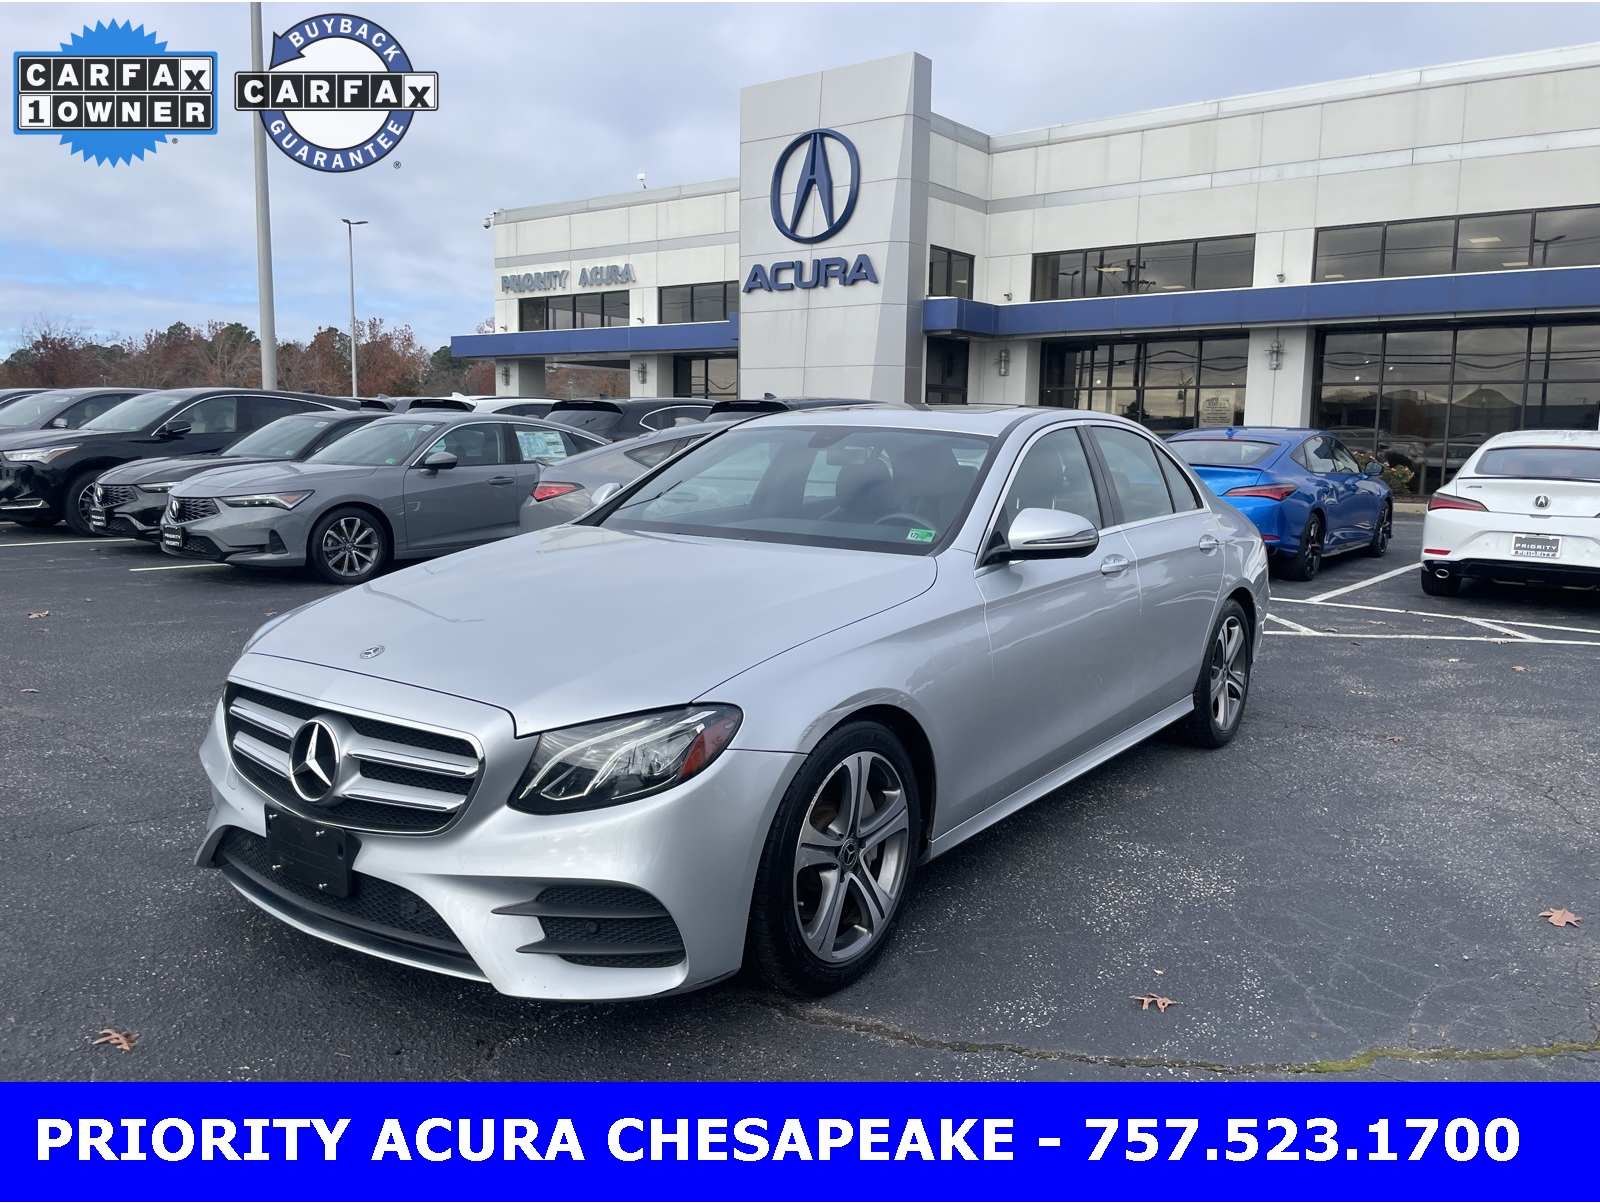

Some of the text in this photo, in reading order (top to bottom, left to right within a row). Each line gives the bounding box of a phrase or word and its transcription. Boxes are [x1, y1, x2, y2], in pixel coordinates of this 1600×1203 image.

[501, 263, 636, 294] PRIORITY ACURA
[742, 253, 879, 294] ACURA
